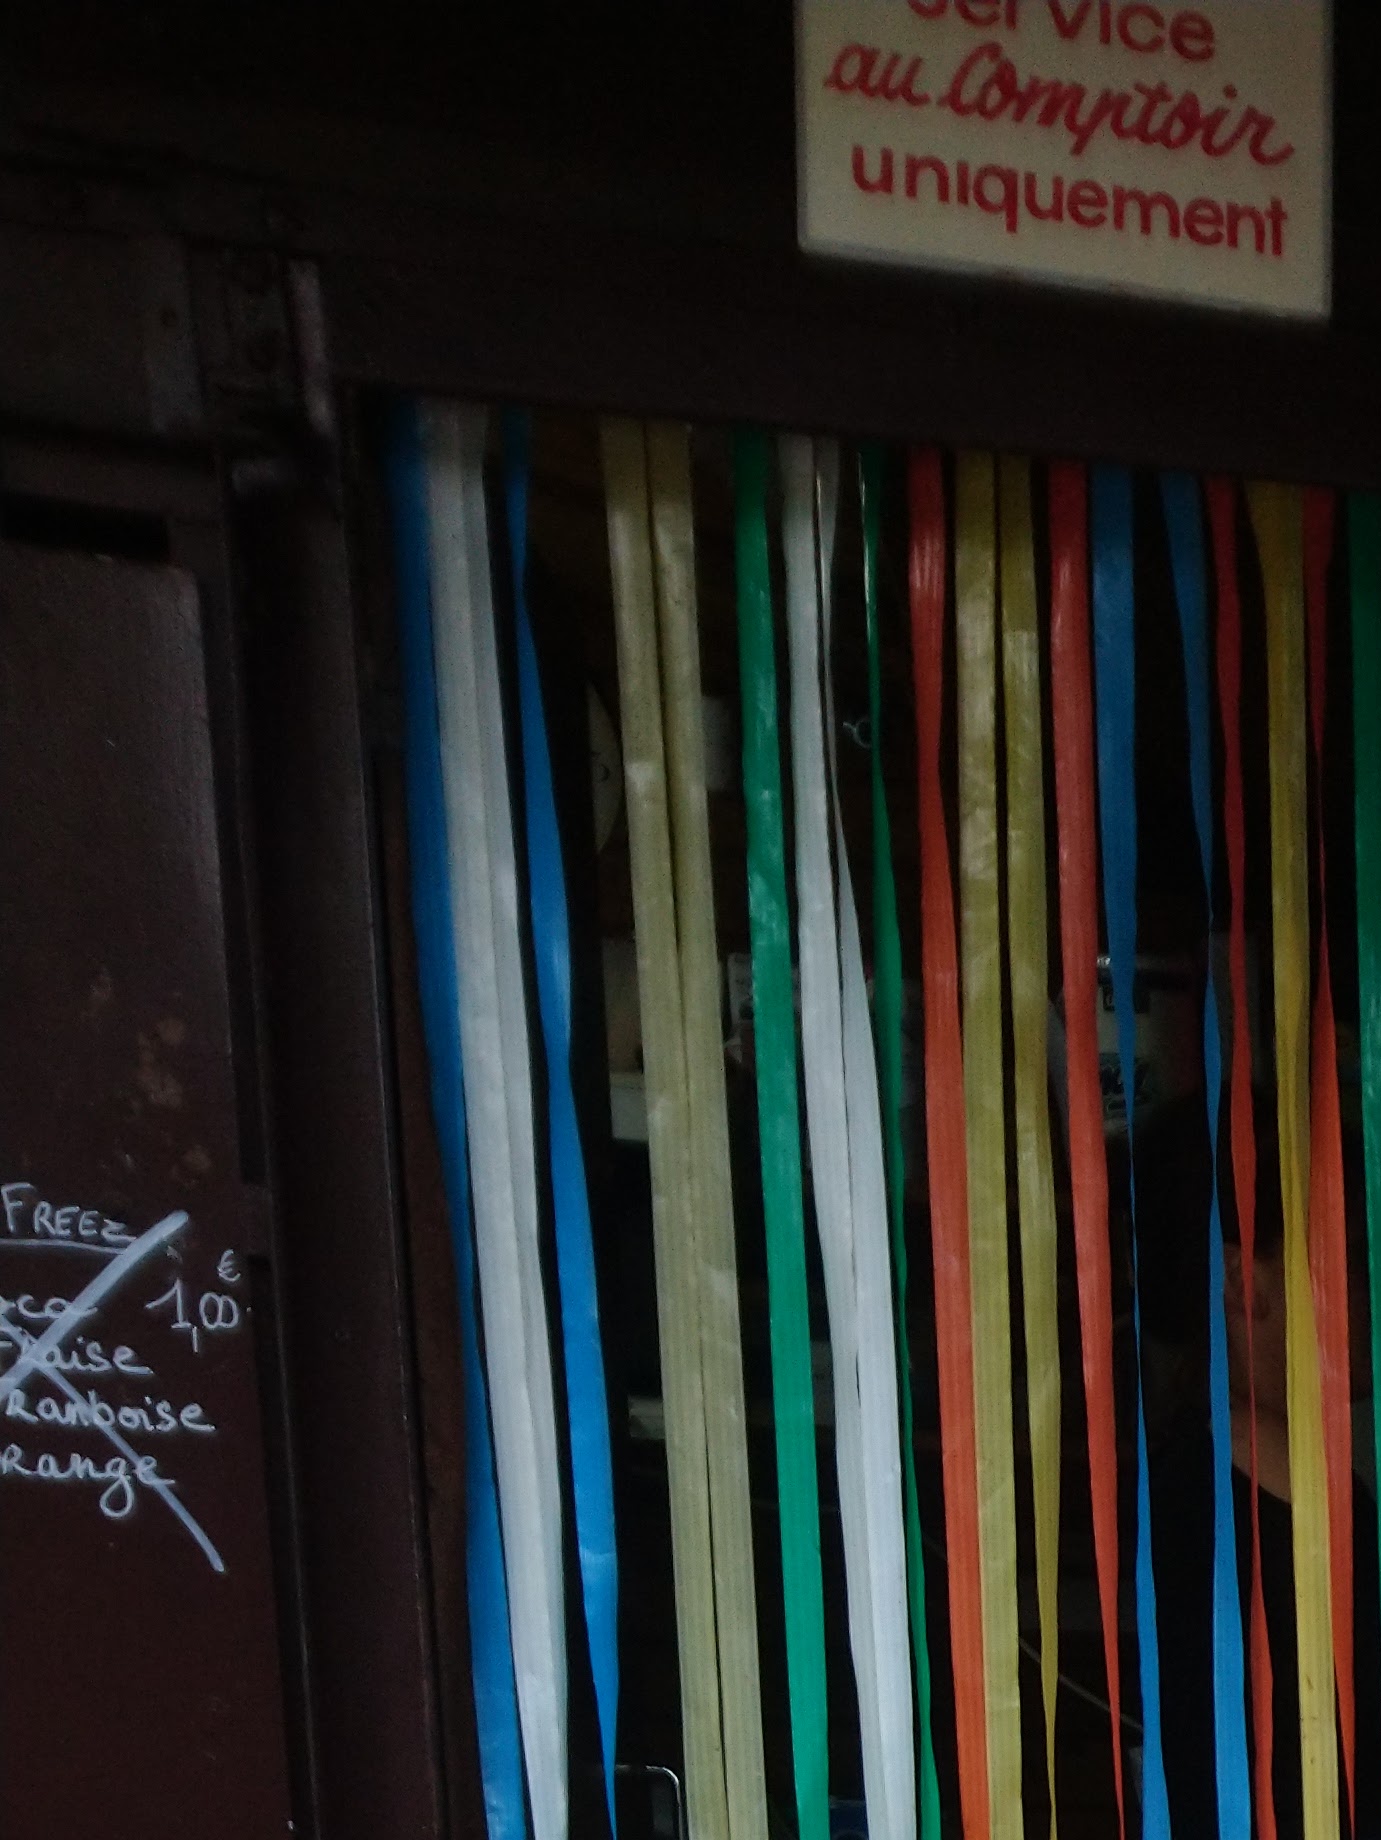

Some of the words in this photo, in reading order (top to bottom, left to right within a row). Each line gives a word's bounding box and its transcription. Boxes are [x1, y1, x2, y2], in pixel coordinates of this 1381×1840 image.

[823, 42, 930, 105] au
[930, 42, 1294, 166] Comptoir
[851, 144, 1288, 256] uniquement
